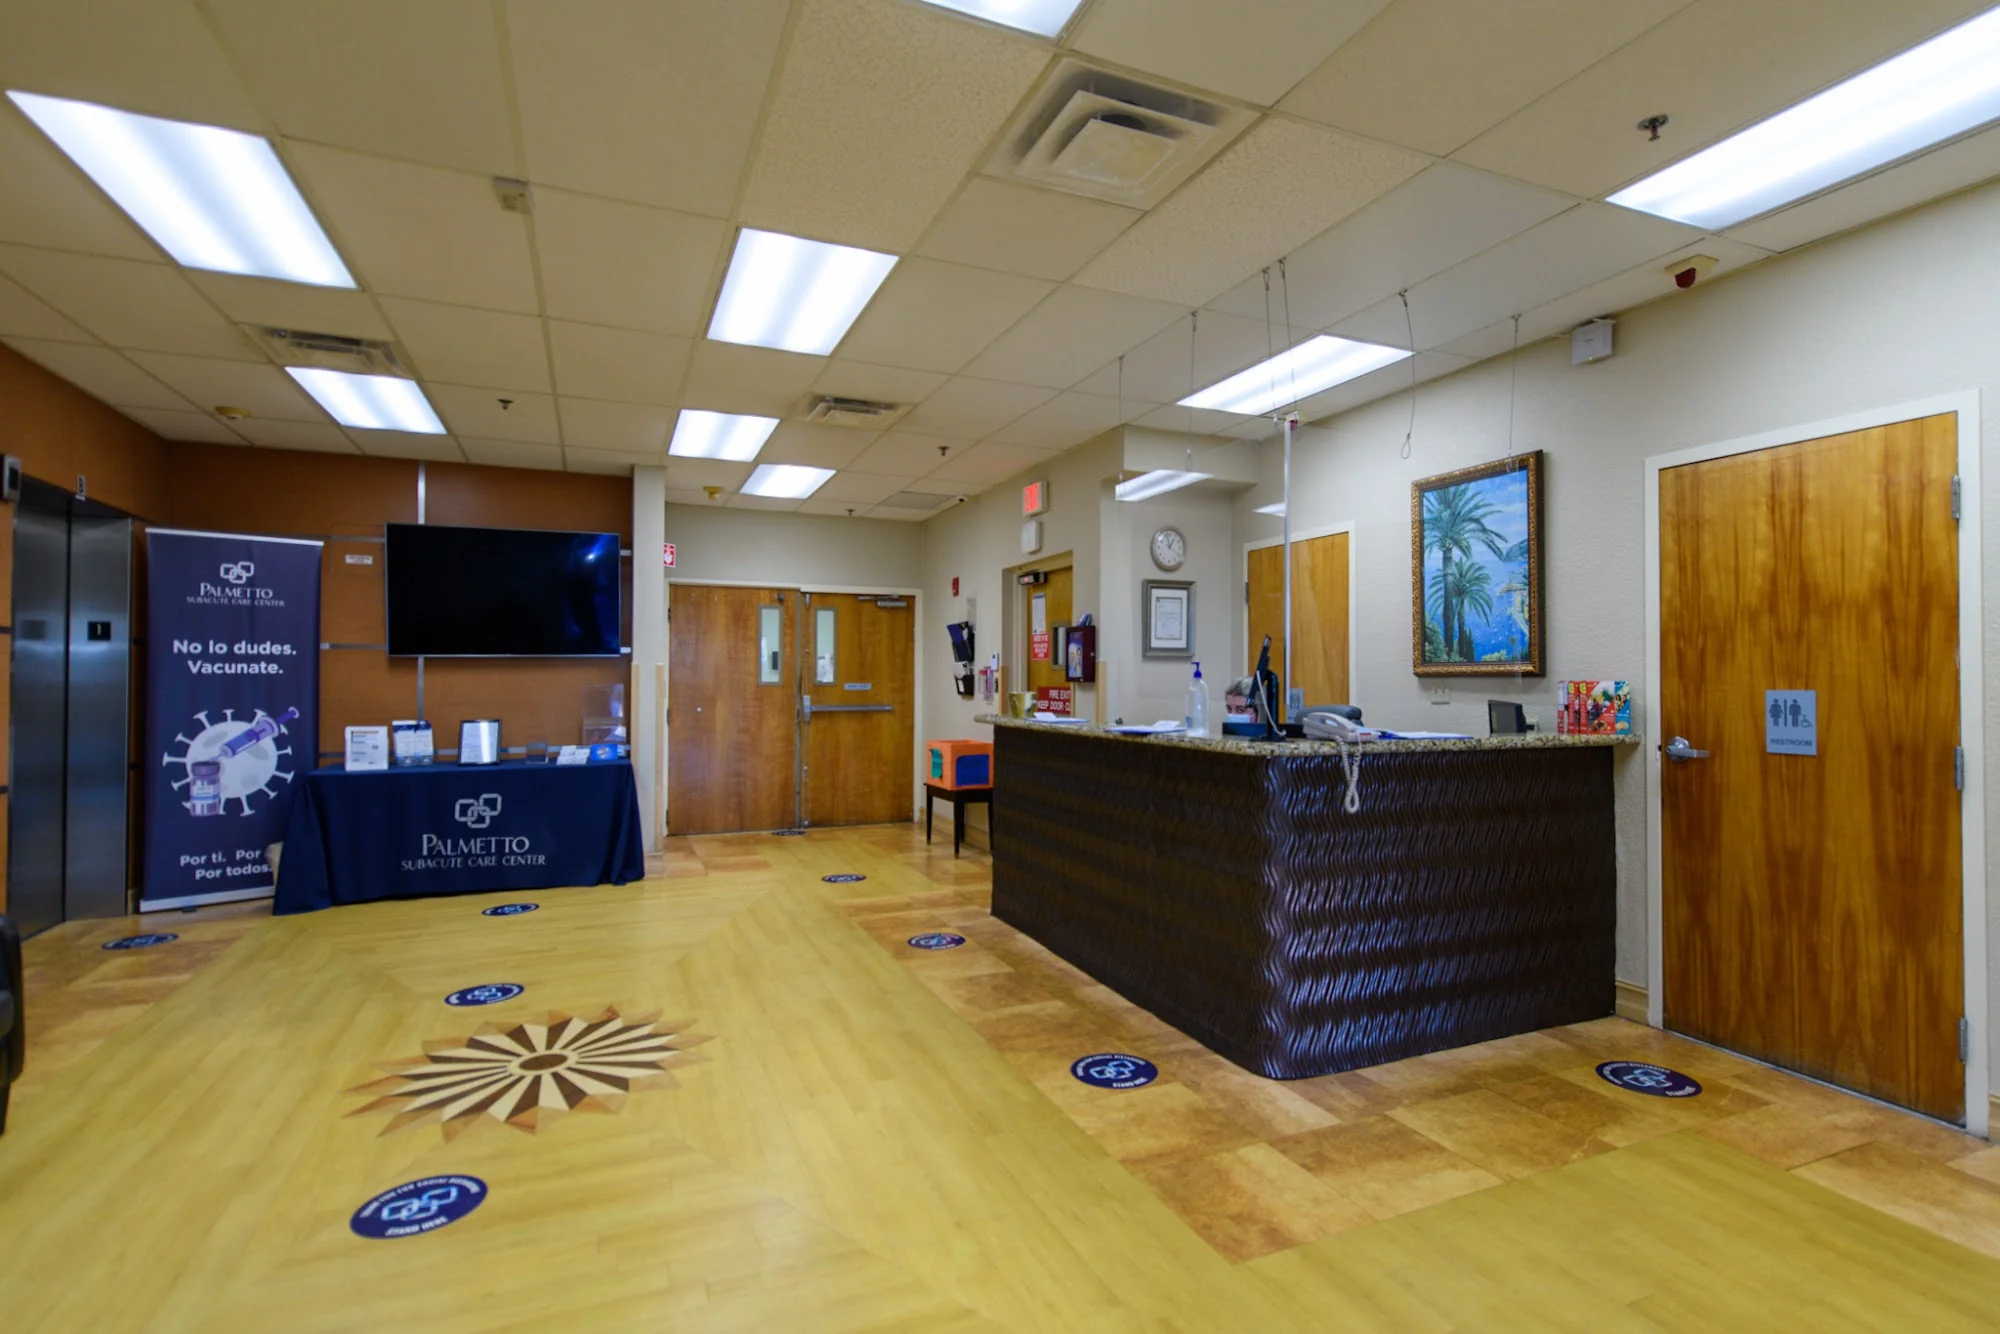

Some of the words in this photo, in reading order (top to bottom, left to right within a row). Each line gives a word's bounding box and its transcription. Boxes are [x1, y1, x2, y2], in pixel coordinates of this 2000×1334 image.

[200, 582, 273, 599] PALMETTO
[173, 639, 202, 654] No
[208, 640, 228, 654] lo
[233, 640, 297, 655] dudes.
[187, 659, 284, 674] Vacunate.
[1770, 738, 1812, 746] RESTROOM
[422, 834, 530, 856] PALMETTO
[180, 854, 207, 867] Por
[211, 851, 227, 863] ti.
[235, 849, 262, 861] Por
[401, 857, 463, 871] SUBACUTE
[467, 856, 497, 867] CARE
[502, 854, 546, 866] CENTER
[195, 868, 222, 880] Por
[226, 863, 272, 876] todos.
